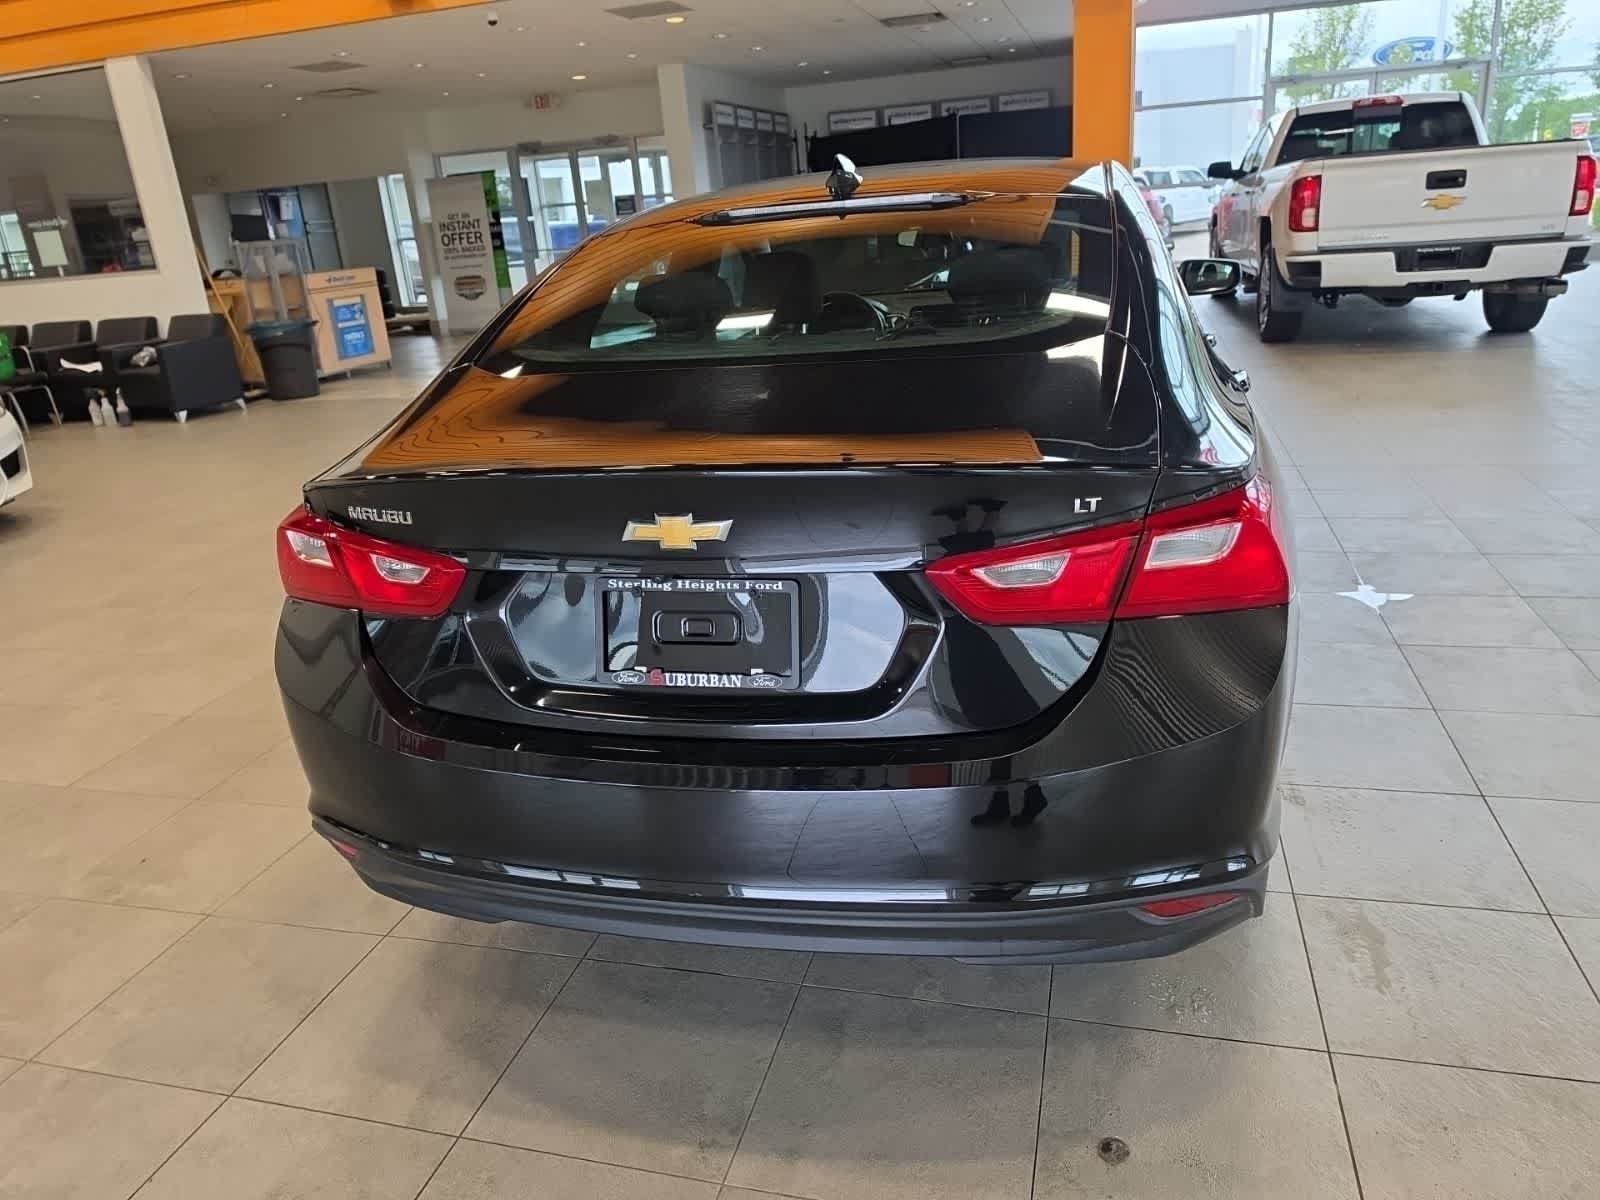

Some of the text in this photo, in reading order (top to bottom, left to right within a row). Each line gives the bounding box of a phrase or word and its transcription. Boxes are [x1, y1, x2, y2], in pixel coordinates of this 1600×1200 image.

[439, 218, 480, 232] INSTANT
[441, 231, 483, 247] OFFER
[1074, 497, 1102, 513] LT
[347, 505, 413, 524] MALIBU
[676, 580, 740, 592] Heights
[745, 581, 783, 591] Ford
[617, 668, 776, 688] Ford SUBURBAN Ford
